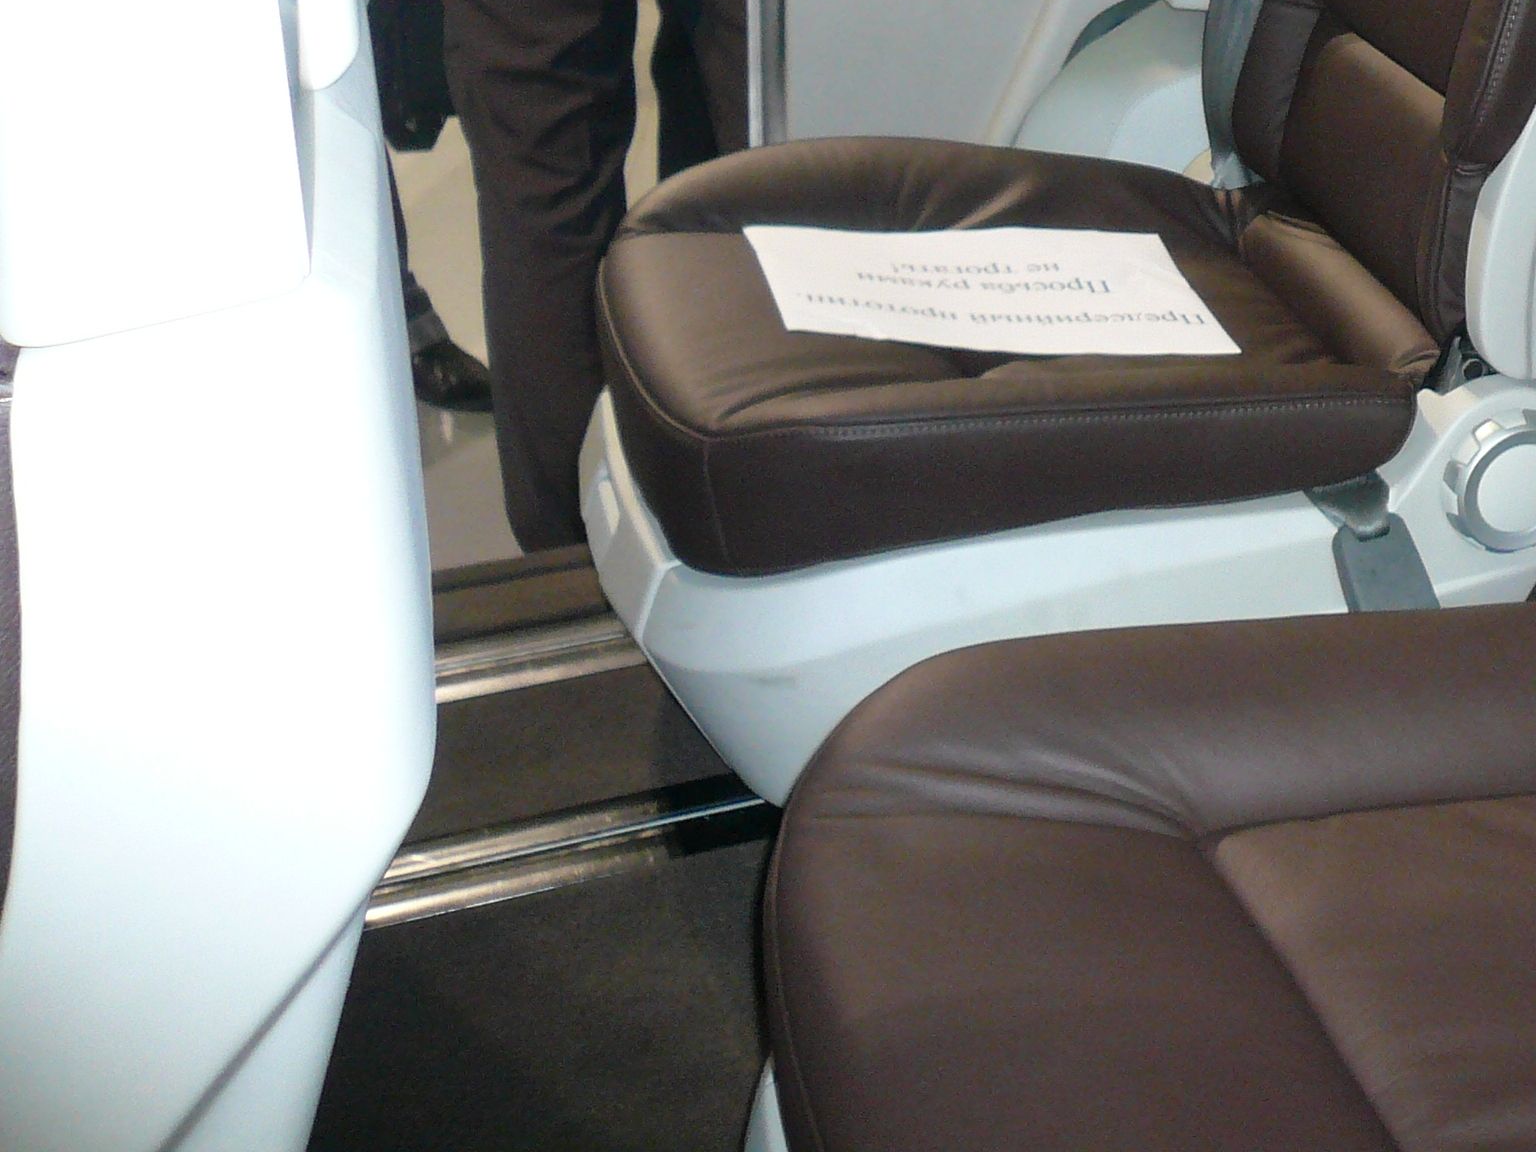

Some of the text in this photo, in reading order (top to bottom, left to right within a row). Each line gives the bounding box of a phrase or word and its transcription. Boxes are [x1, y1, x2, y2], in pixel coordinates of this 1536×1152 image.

[892, 261, 1061, 274] не трогать!
[857, 271, 1111, 294] Просьба руками
